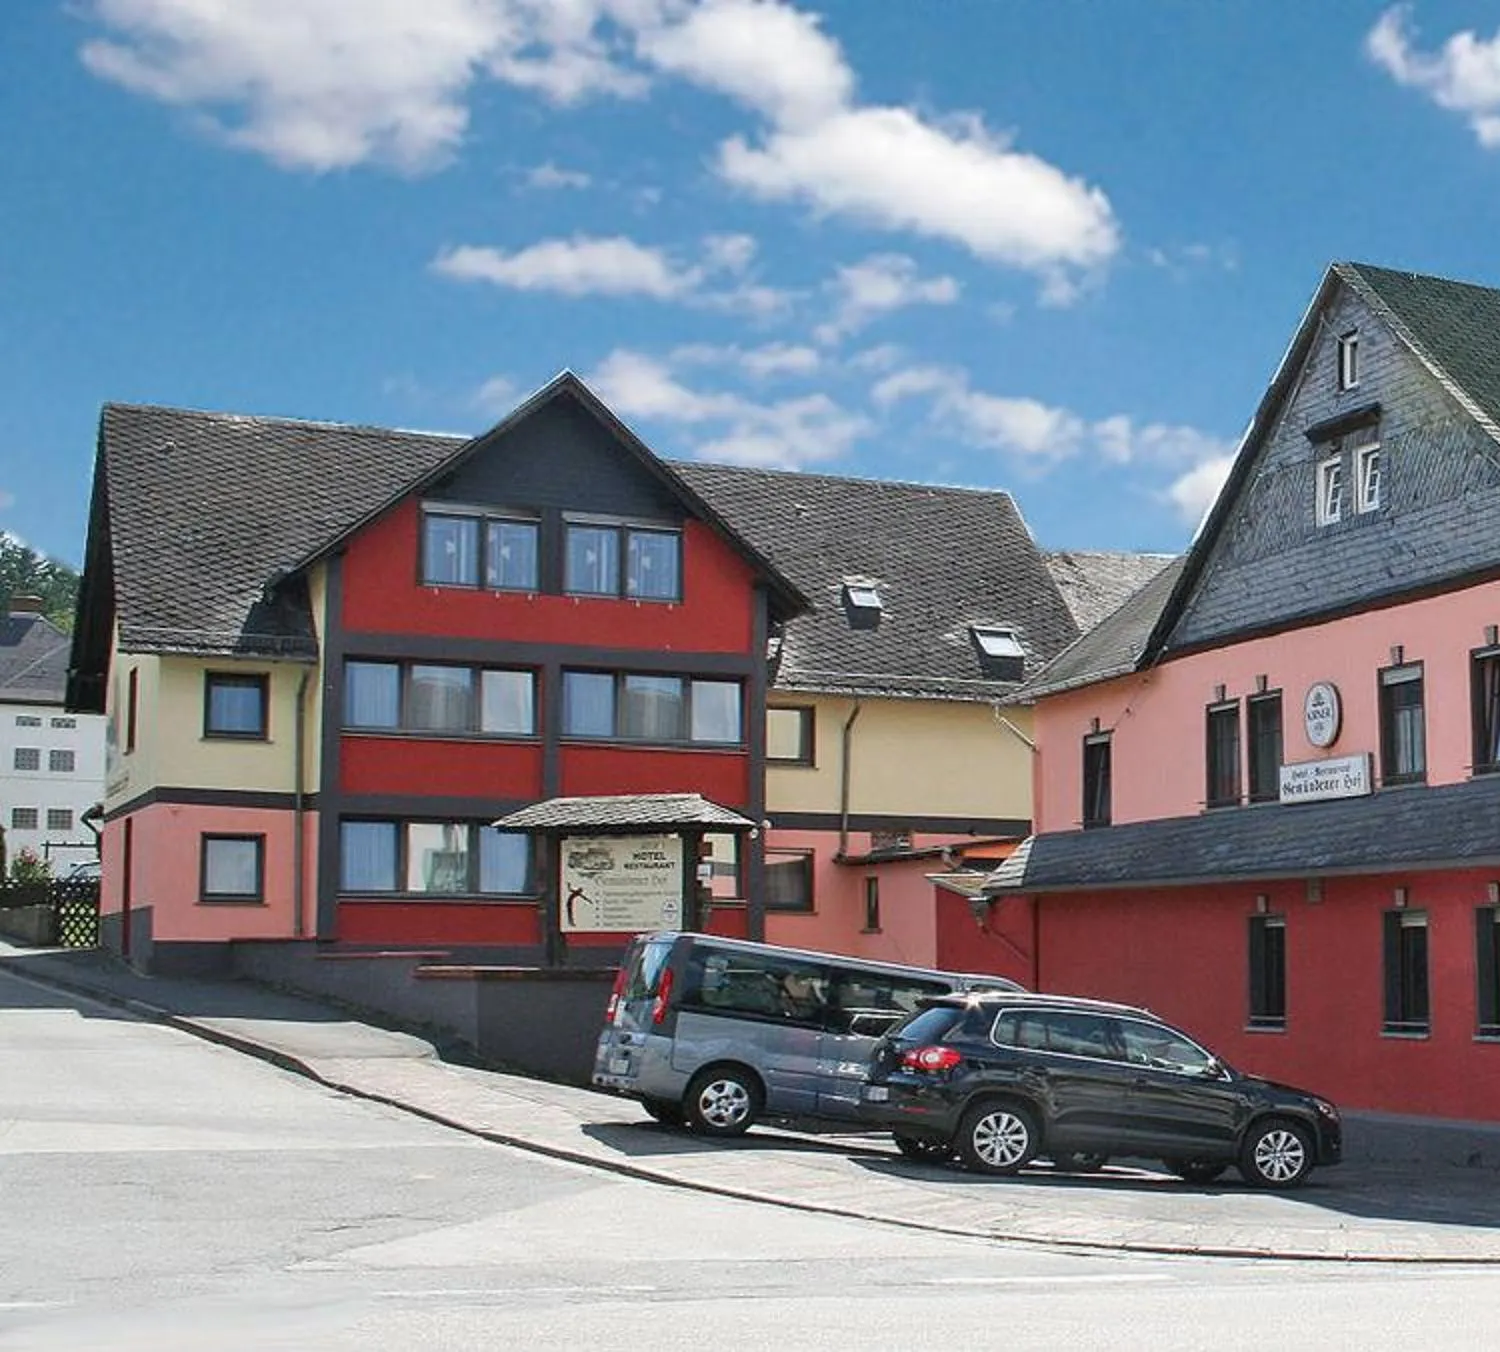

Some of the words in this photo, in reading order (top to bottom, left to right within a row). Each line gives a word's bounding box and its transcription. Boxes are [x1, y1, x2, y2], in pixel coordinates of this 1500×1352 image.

[1281, 777, 1340, 795] Gemündener
[1343, 772, 1362, 789] Hof
[632, 851, 667, 861] HOTEL
[623, 861, 676, 870] RESTAURANT
